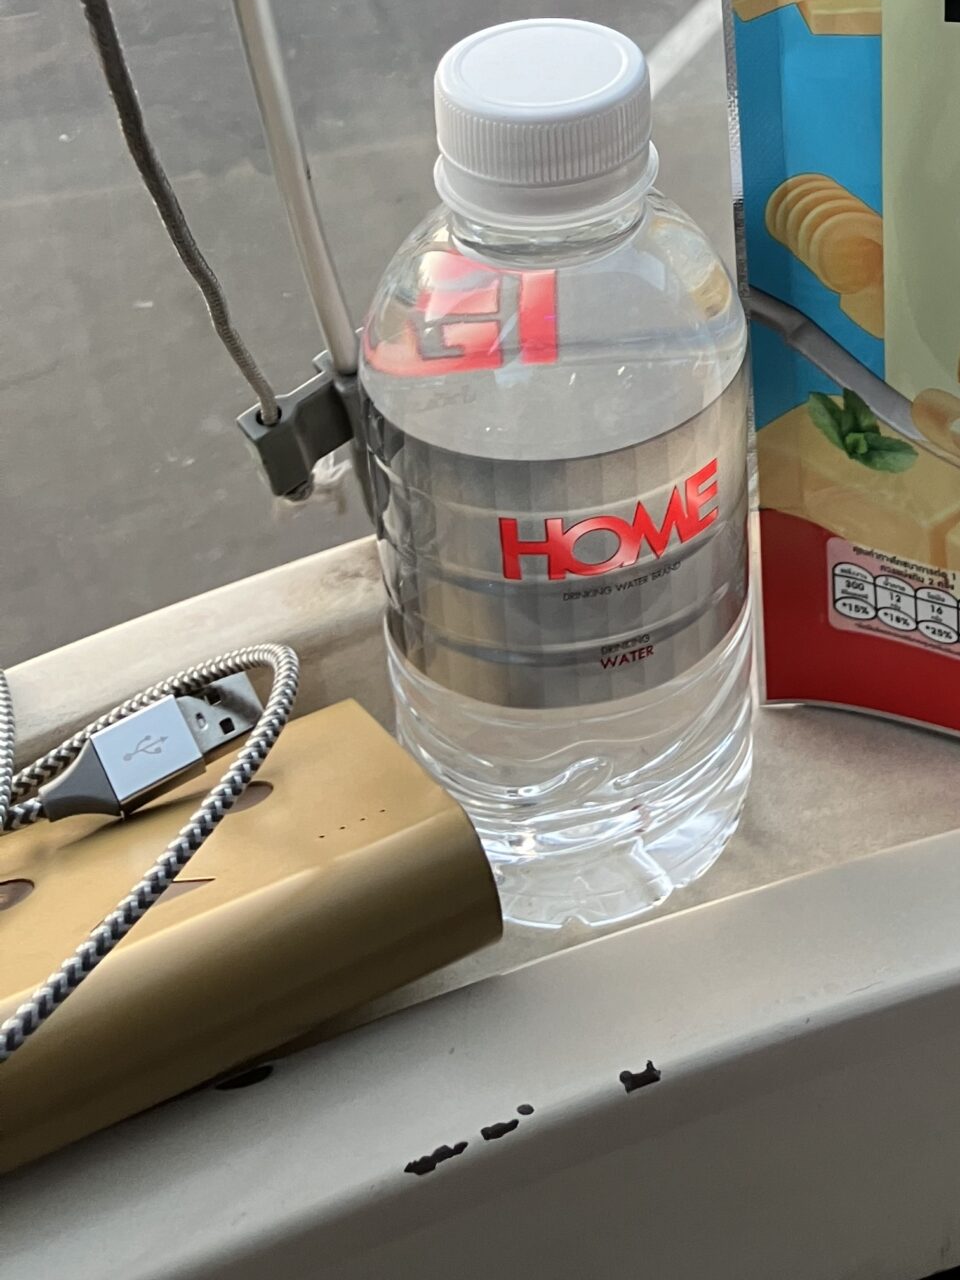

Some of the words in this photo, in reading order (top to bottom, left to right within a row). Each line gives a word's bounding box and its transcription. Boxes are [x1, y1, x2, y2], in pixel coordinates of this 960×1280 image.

[498, 457, 719, 581] HOME
[562, 585, 613, 602] DRINKING
[615, 575, 649, 592] WATER
[651, 561, 682, 582] BRAND
[889, 592, 902, 604] 12
[930, 604, 943, 615] 16
[600, 633, 650, 656] DRINKING
[600, 645, 655, 669] WATER
